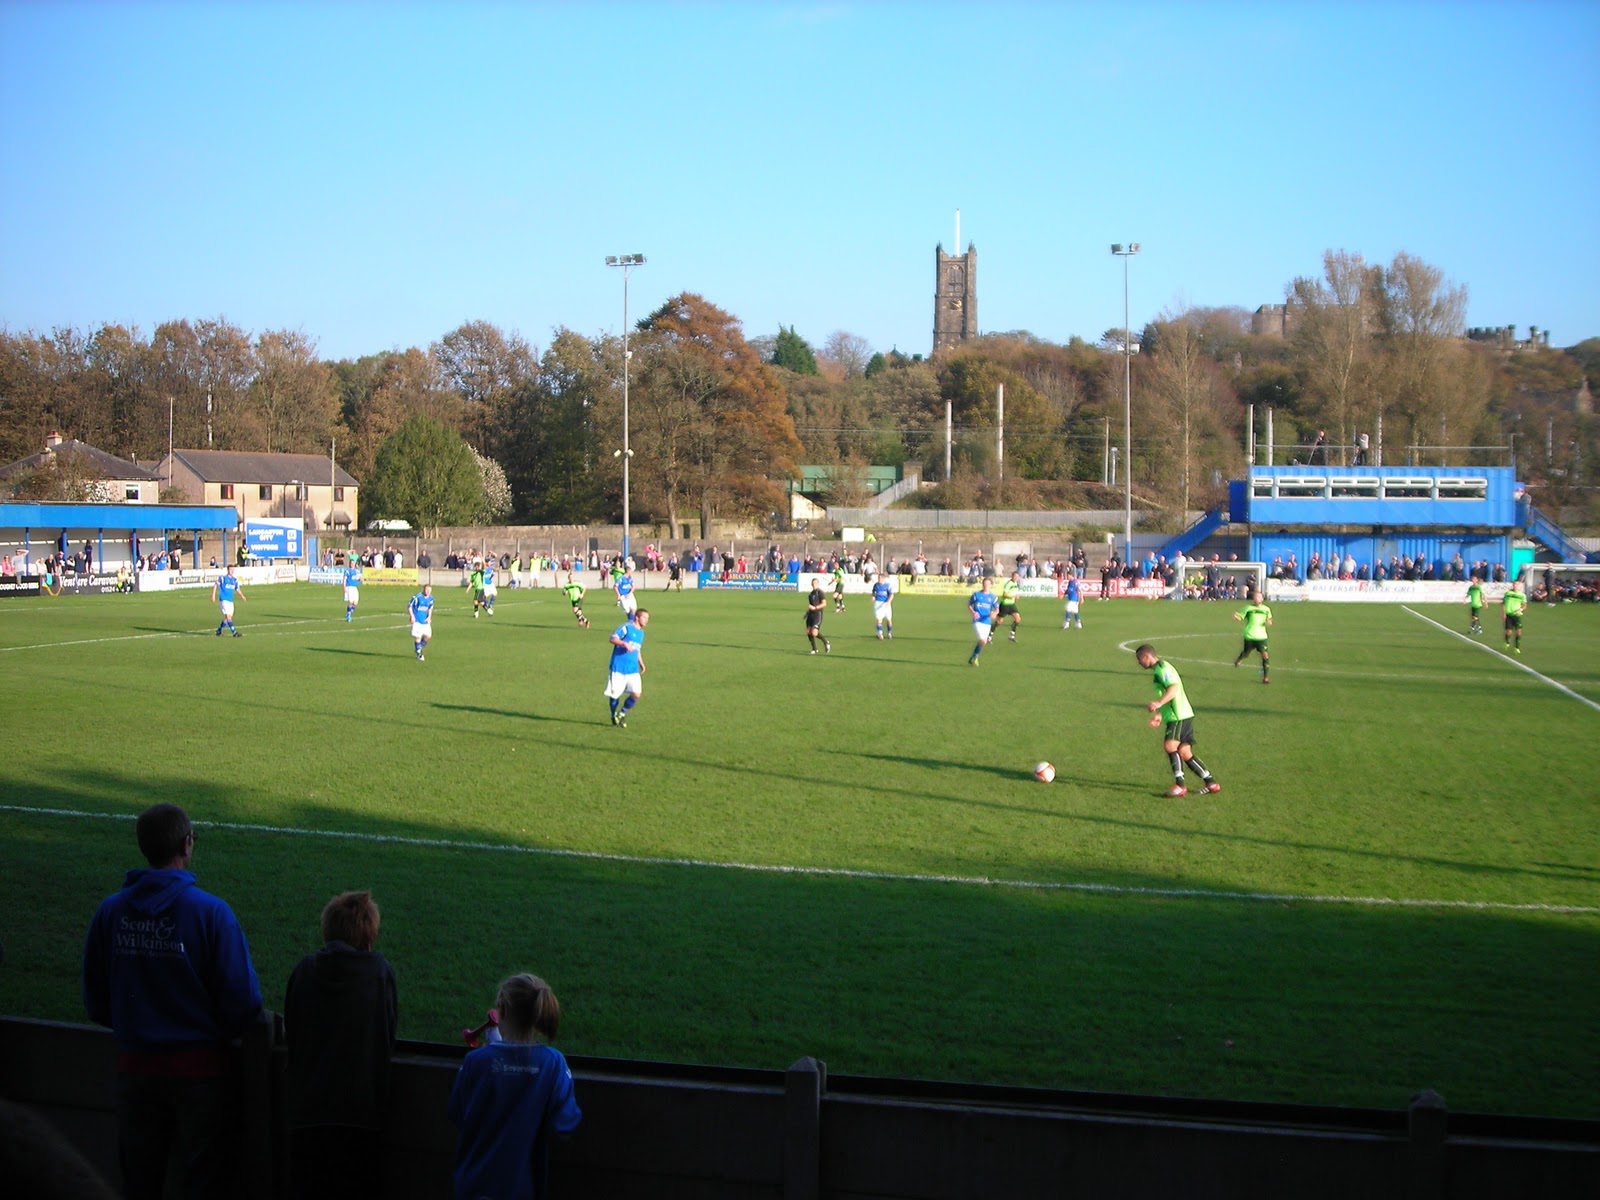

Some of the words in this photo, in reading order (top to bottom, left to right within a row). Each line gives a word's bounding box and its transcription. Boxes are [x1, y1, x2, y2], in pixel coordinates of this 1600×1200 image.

[1040, 584, 1054, 593] Pies
[121, 916, 155, 932] Scott
[155, 917, 176, 940] &
[115, 933, 185, 953] Wilkinson
